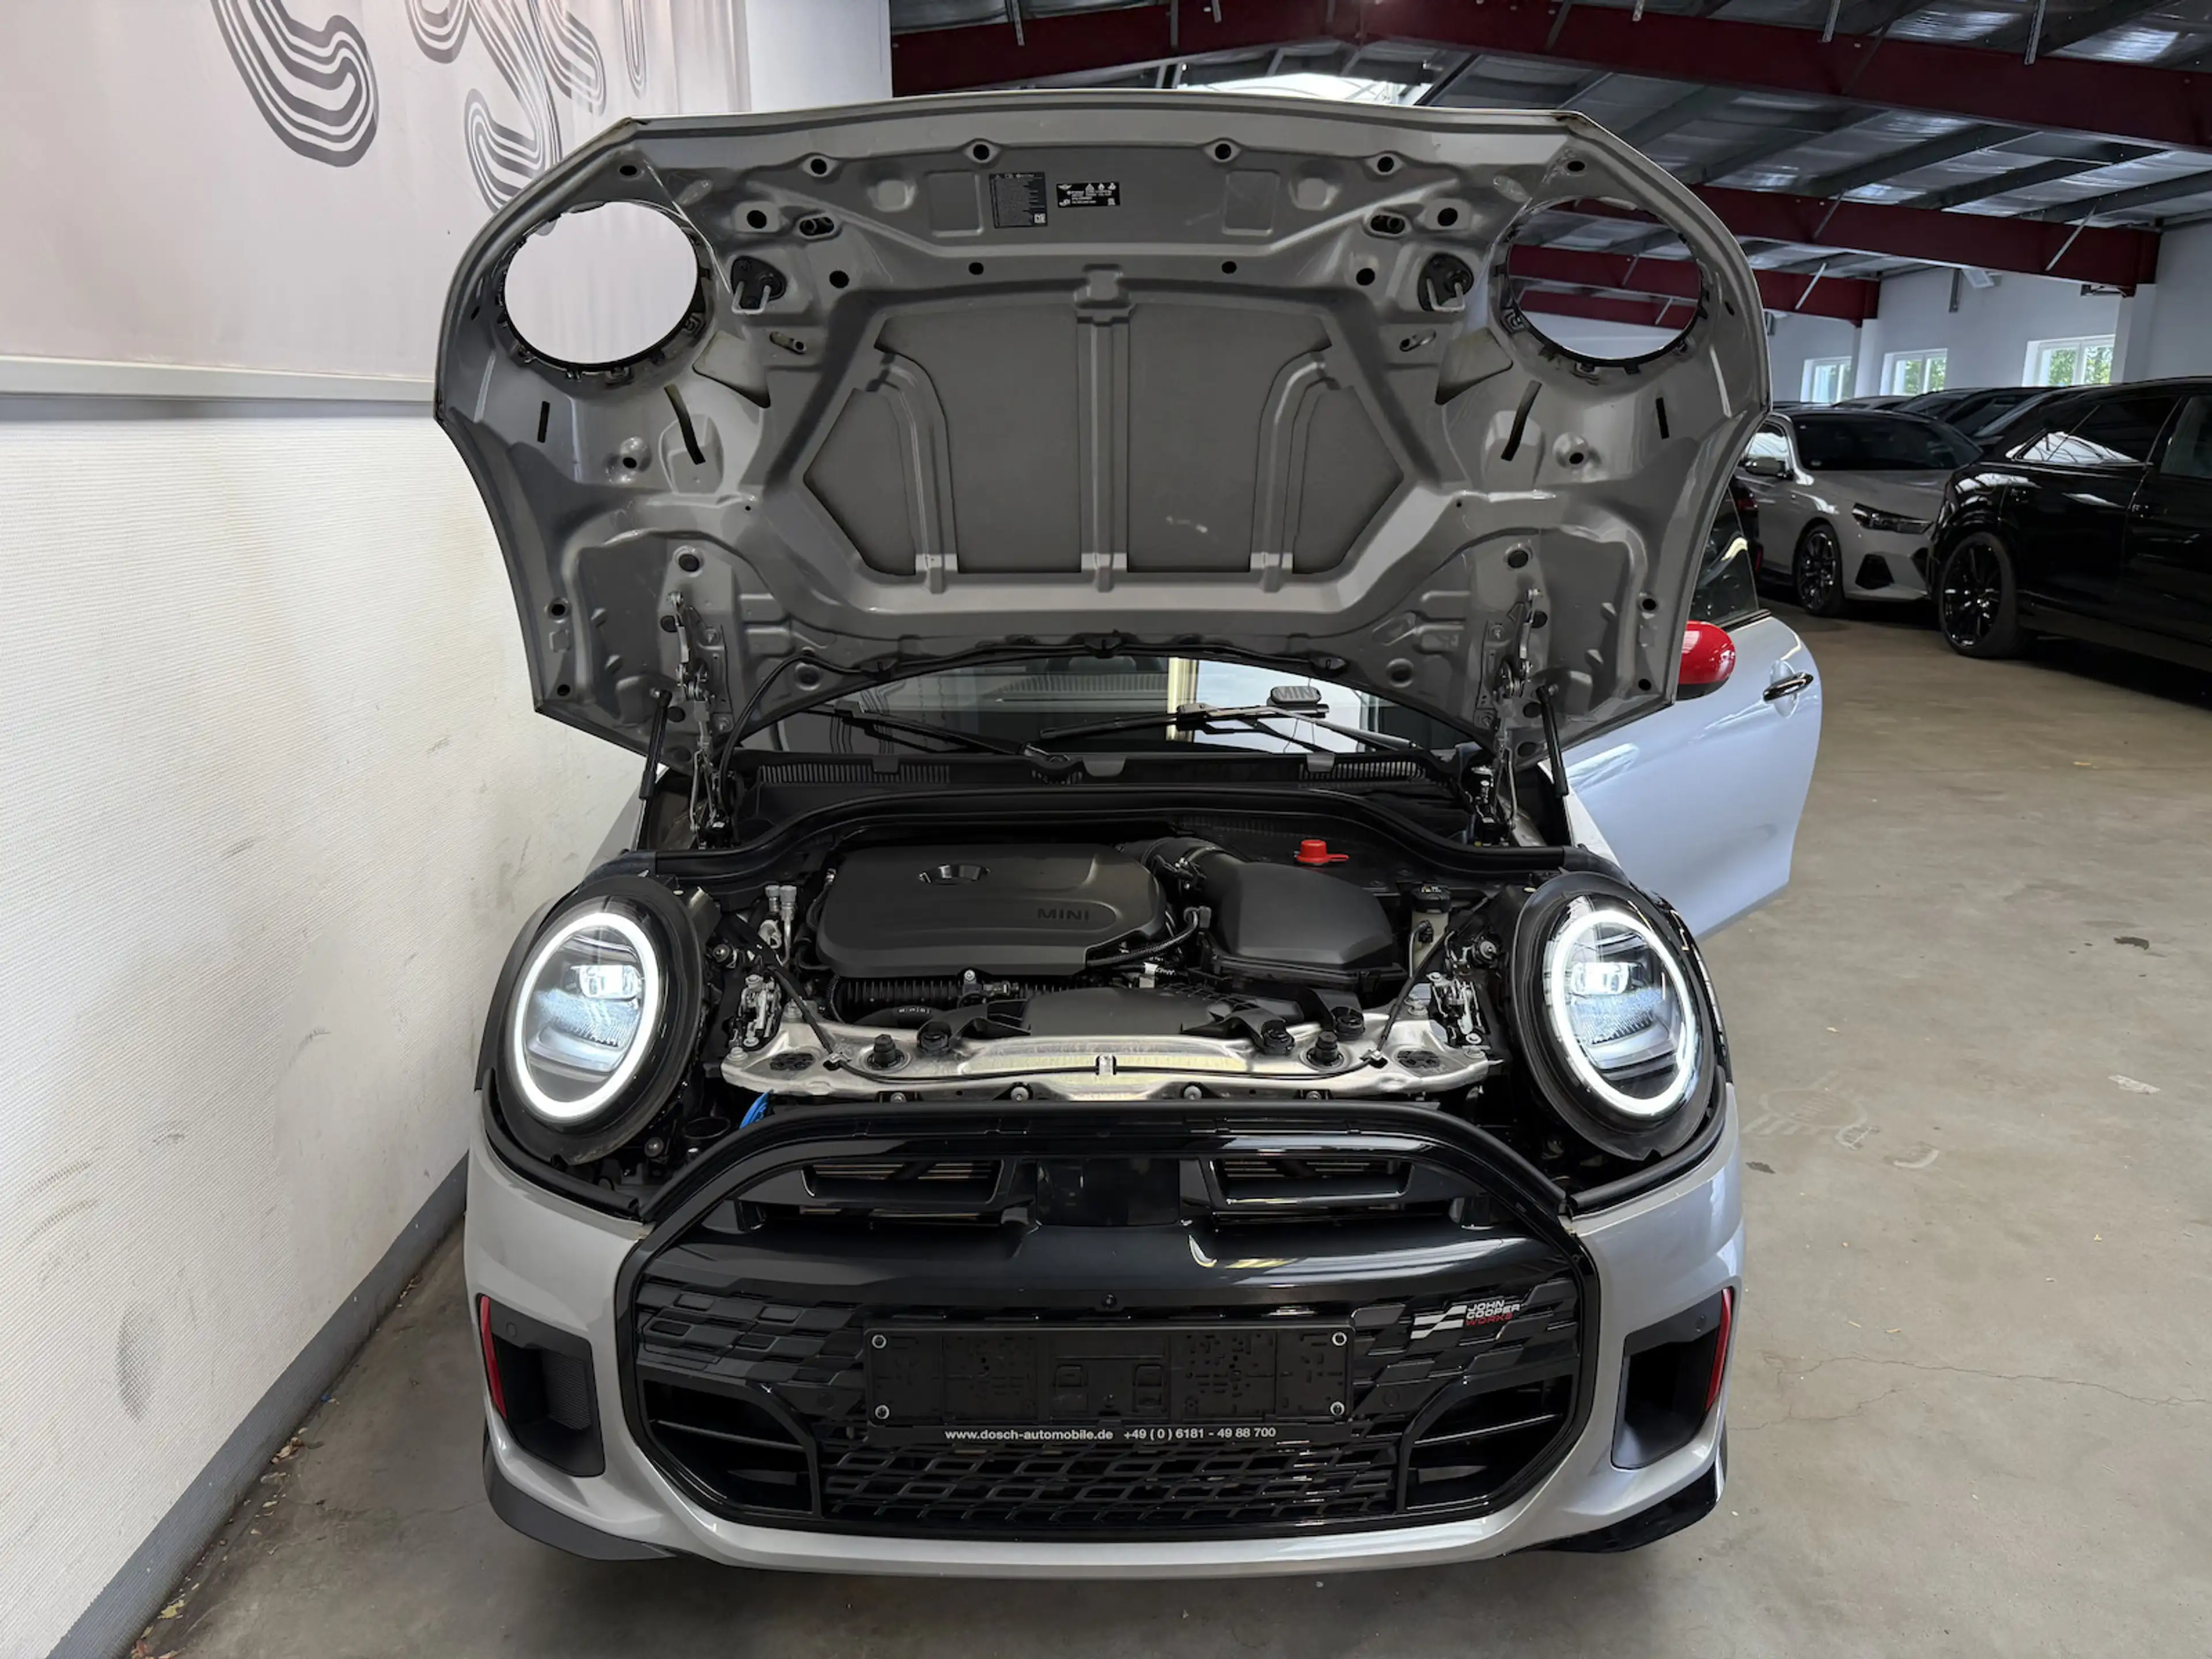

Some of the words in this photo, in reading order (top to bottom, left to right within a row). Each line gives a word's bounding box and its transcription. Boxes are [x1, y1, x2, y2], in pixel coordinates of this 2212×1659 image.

[1037, 907, 1089, 921] MINI
[1467, 1304, 1520, 1319] COOPER
[1468, 1300, 1505, 1312] JOHN
[1465, 1312, 1513, 1325] WORKS
[945, 1429, 1113, 1440] www.dosch-automobile.de
[1124, 1429, 1147, 1439] +49
[1175, 1428, 1204, 1439] 6181
[1217, 1428, 1232, 1438] 49
[1235, 1428, 1251, 1438] 88
[1253, 1427, 1277, 1438] 700
